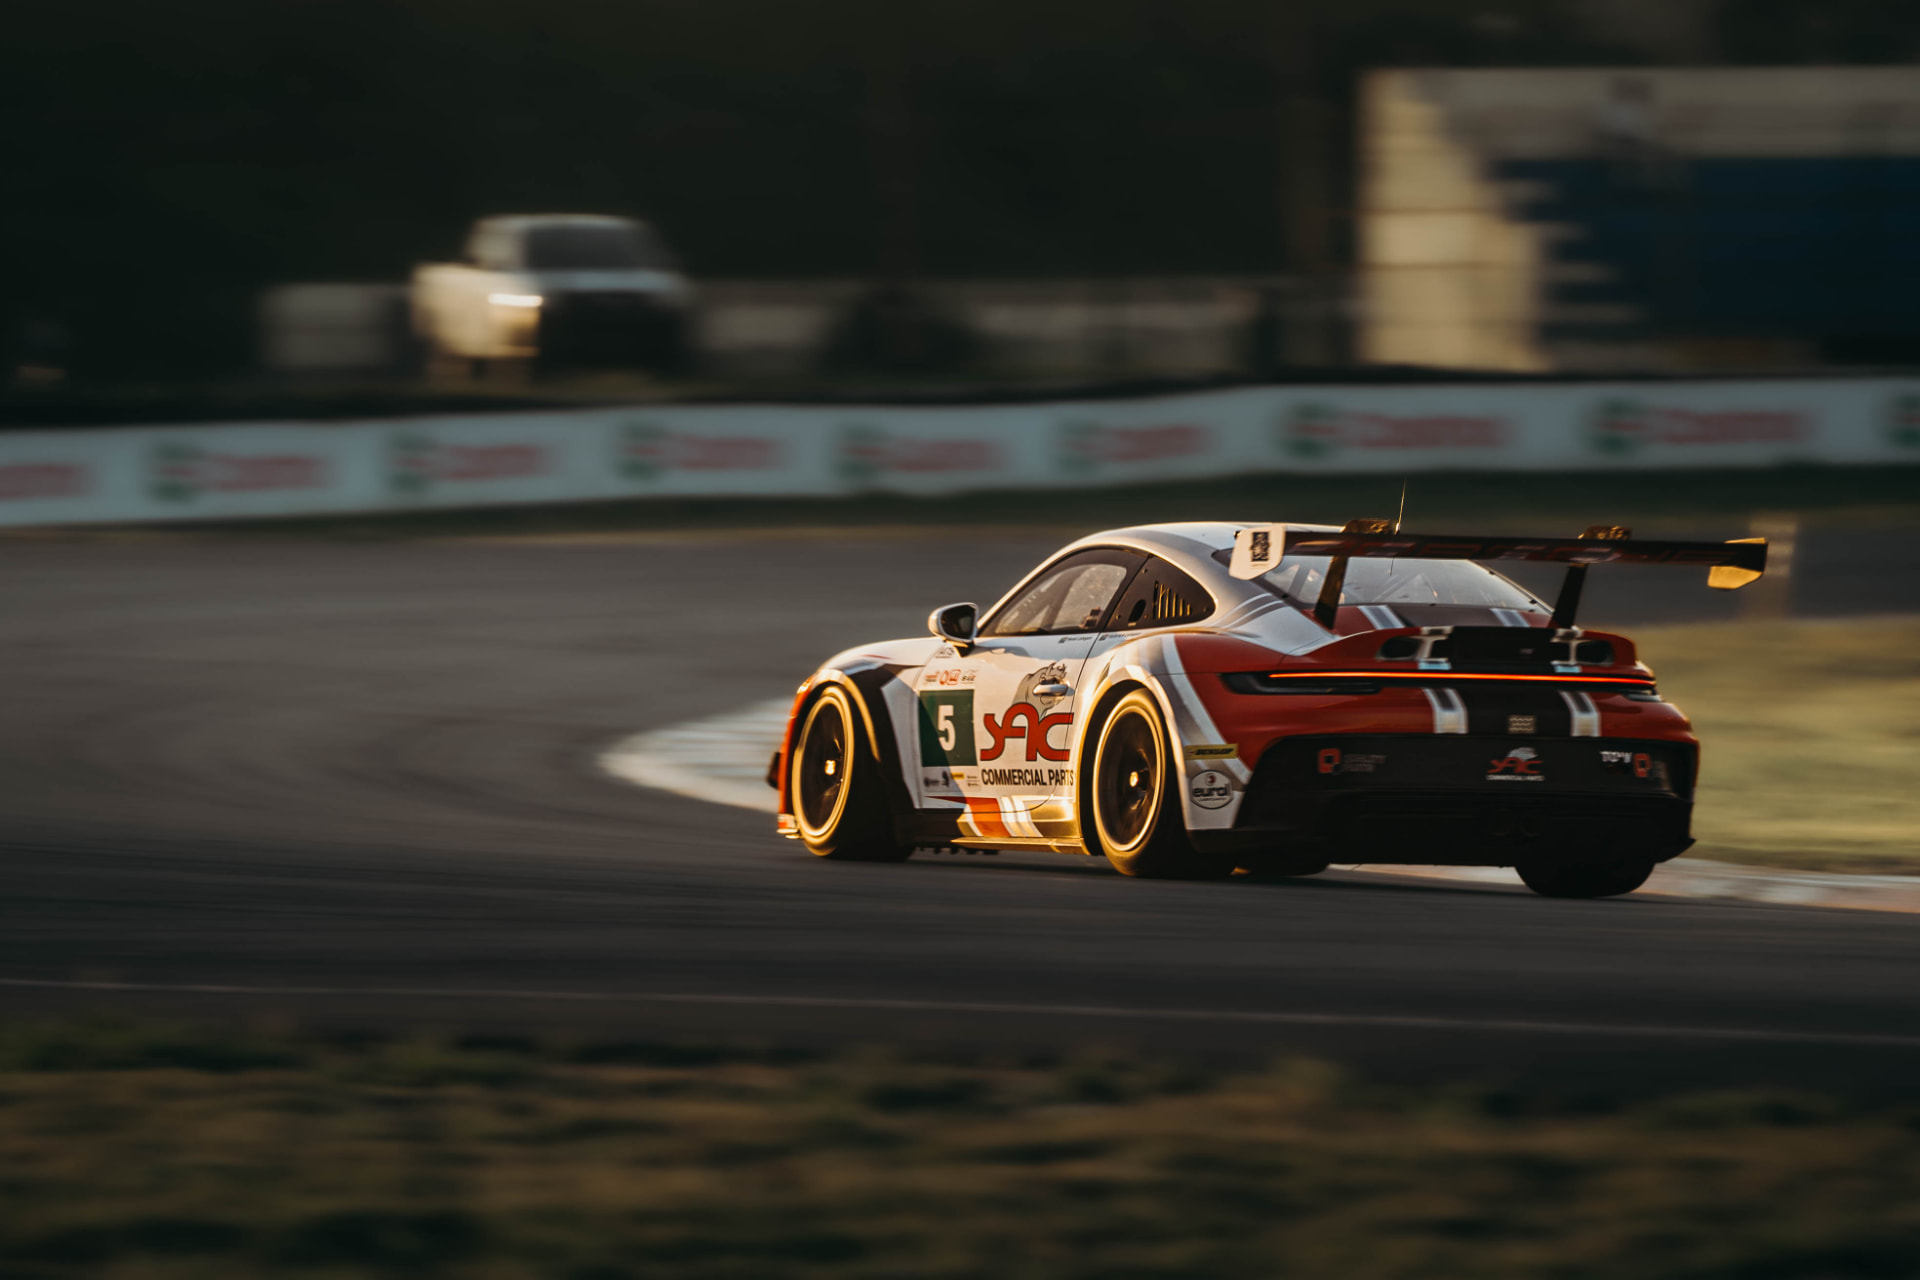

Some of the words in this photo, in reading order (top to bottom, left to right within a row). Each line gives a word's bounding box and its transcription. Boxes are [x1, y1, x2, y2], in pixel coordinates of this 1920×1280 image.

[938, 704, 956, 751] 5
[979, 702, 1075, 761] SAC
[981, 768, 1047, 786] COMMERCIAL
[1048, 768, 1075, 786] PARTS
[1192, 783, 1231, 797] eurol
